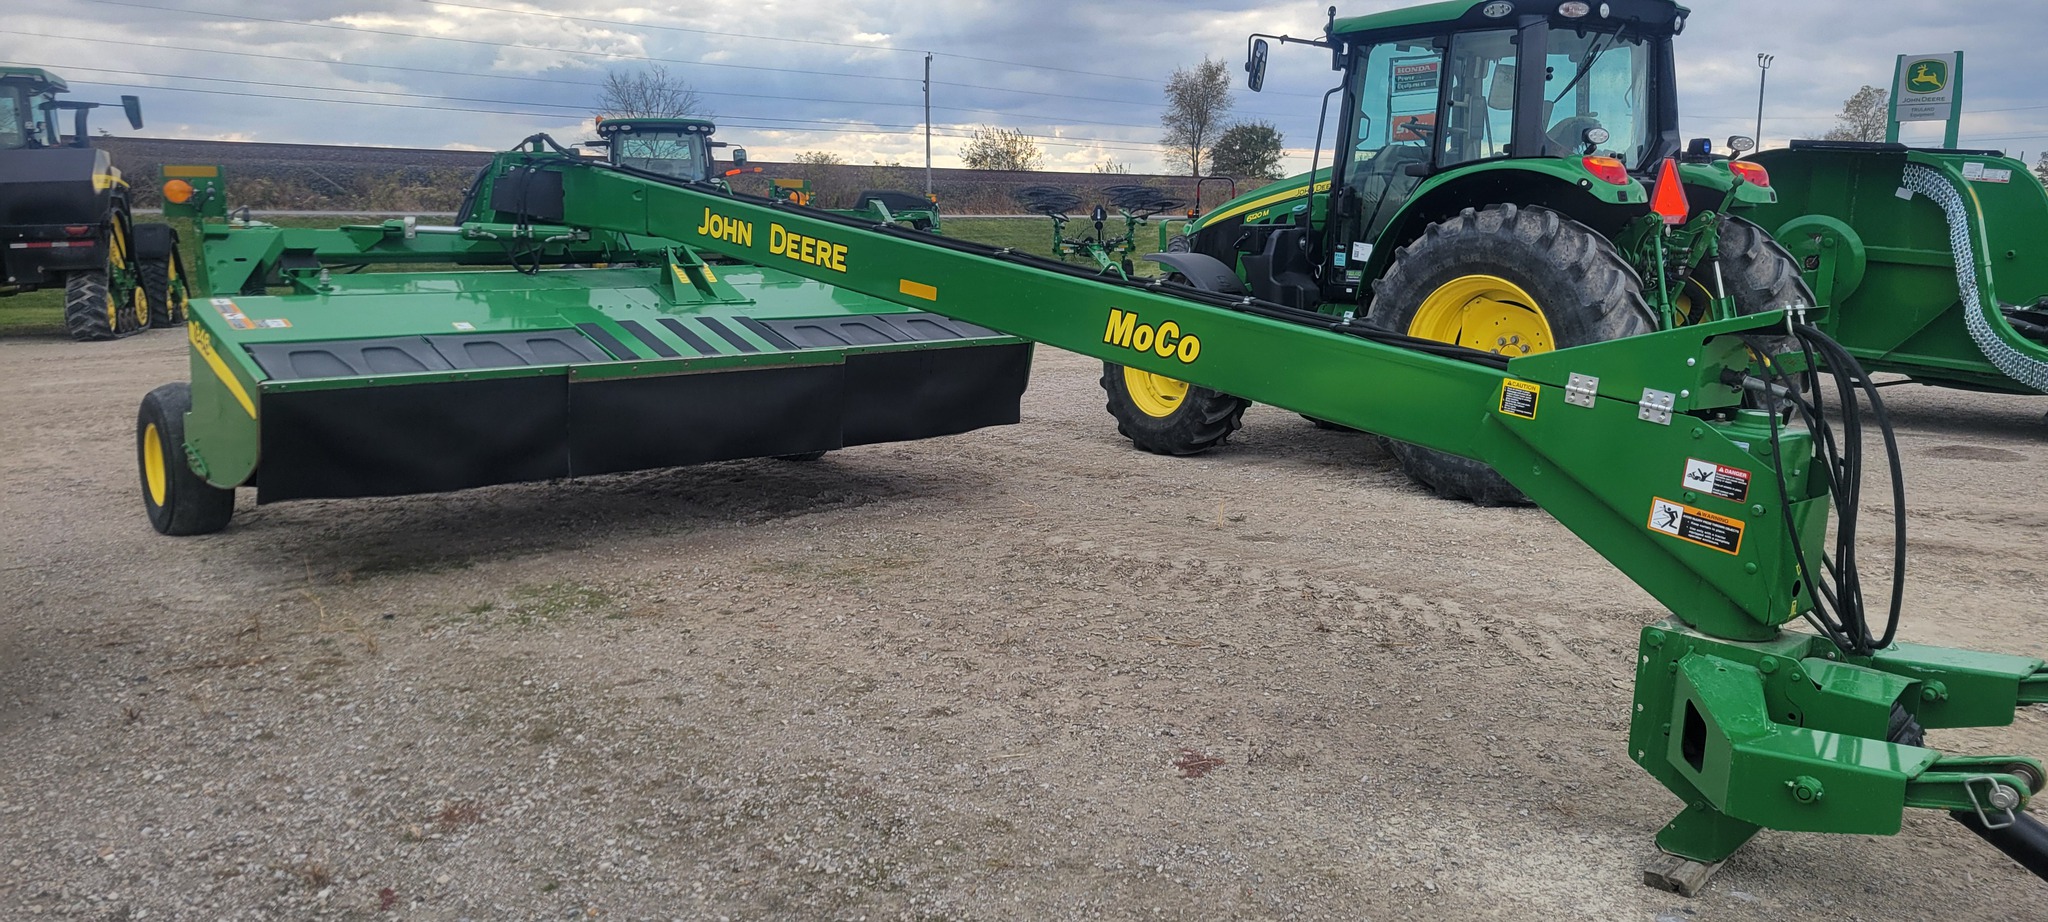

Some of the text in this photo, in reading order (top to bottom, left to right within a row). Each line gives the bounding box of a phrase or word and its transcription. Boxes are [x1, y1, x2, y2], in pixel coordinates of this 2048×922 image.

[1397, 65, 1431, 74] HONDA
[697, 206, 848, 273] JOHN DEERE
[1103, 307, 1201, 364] MoCo
[1513, 381, 1536, 391] CAUTION
[1724, 468, 1747, 478] DANGER
[1702, 512, 1729, 524] WARNING
